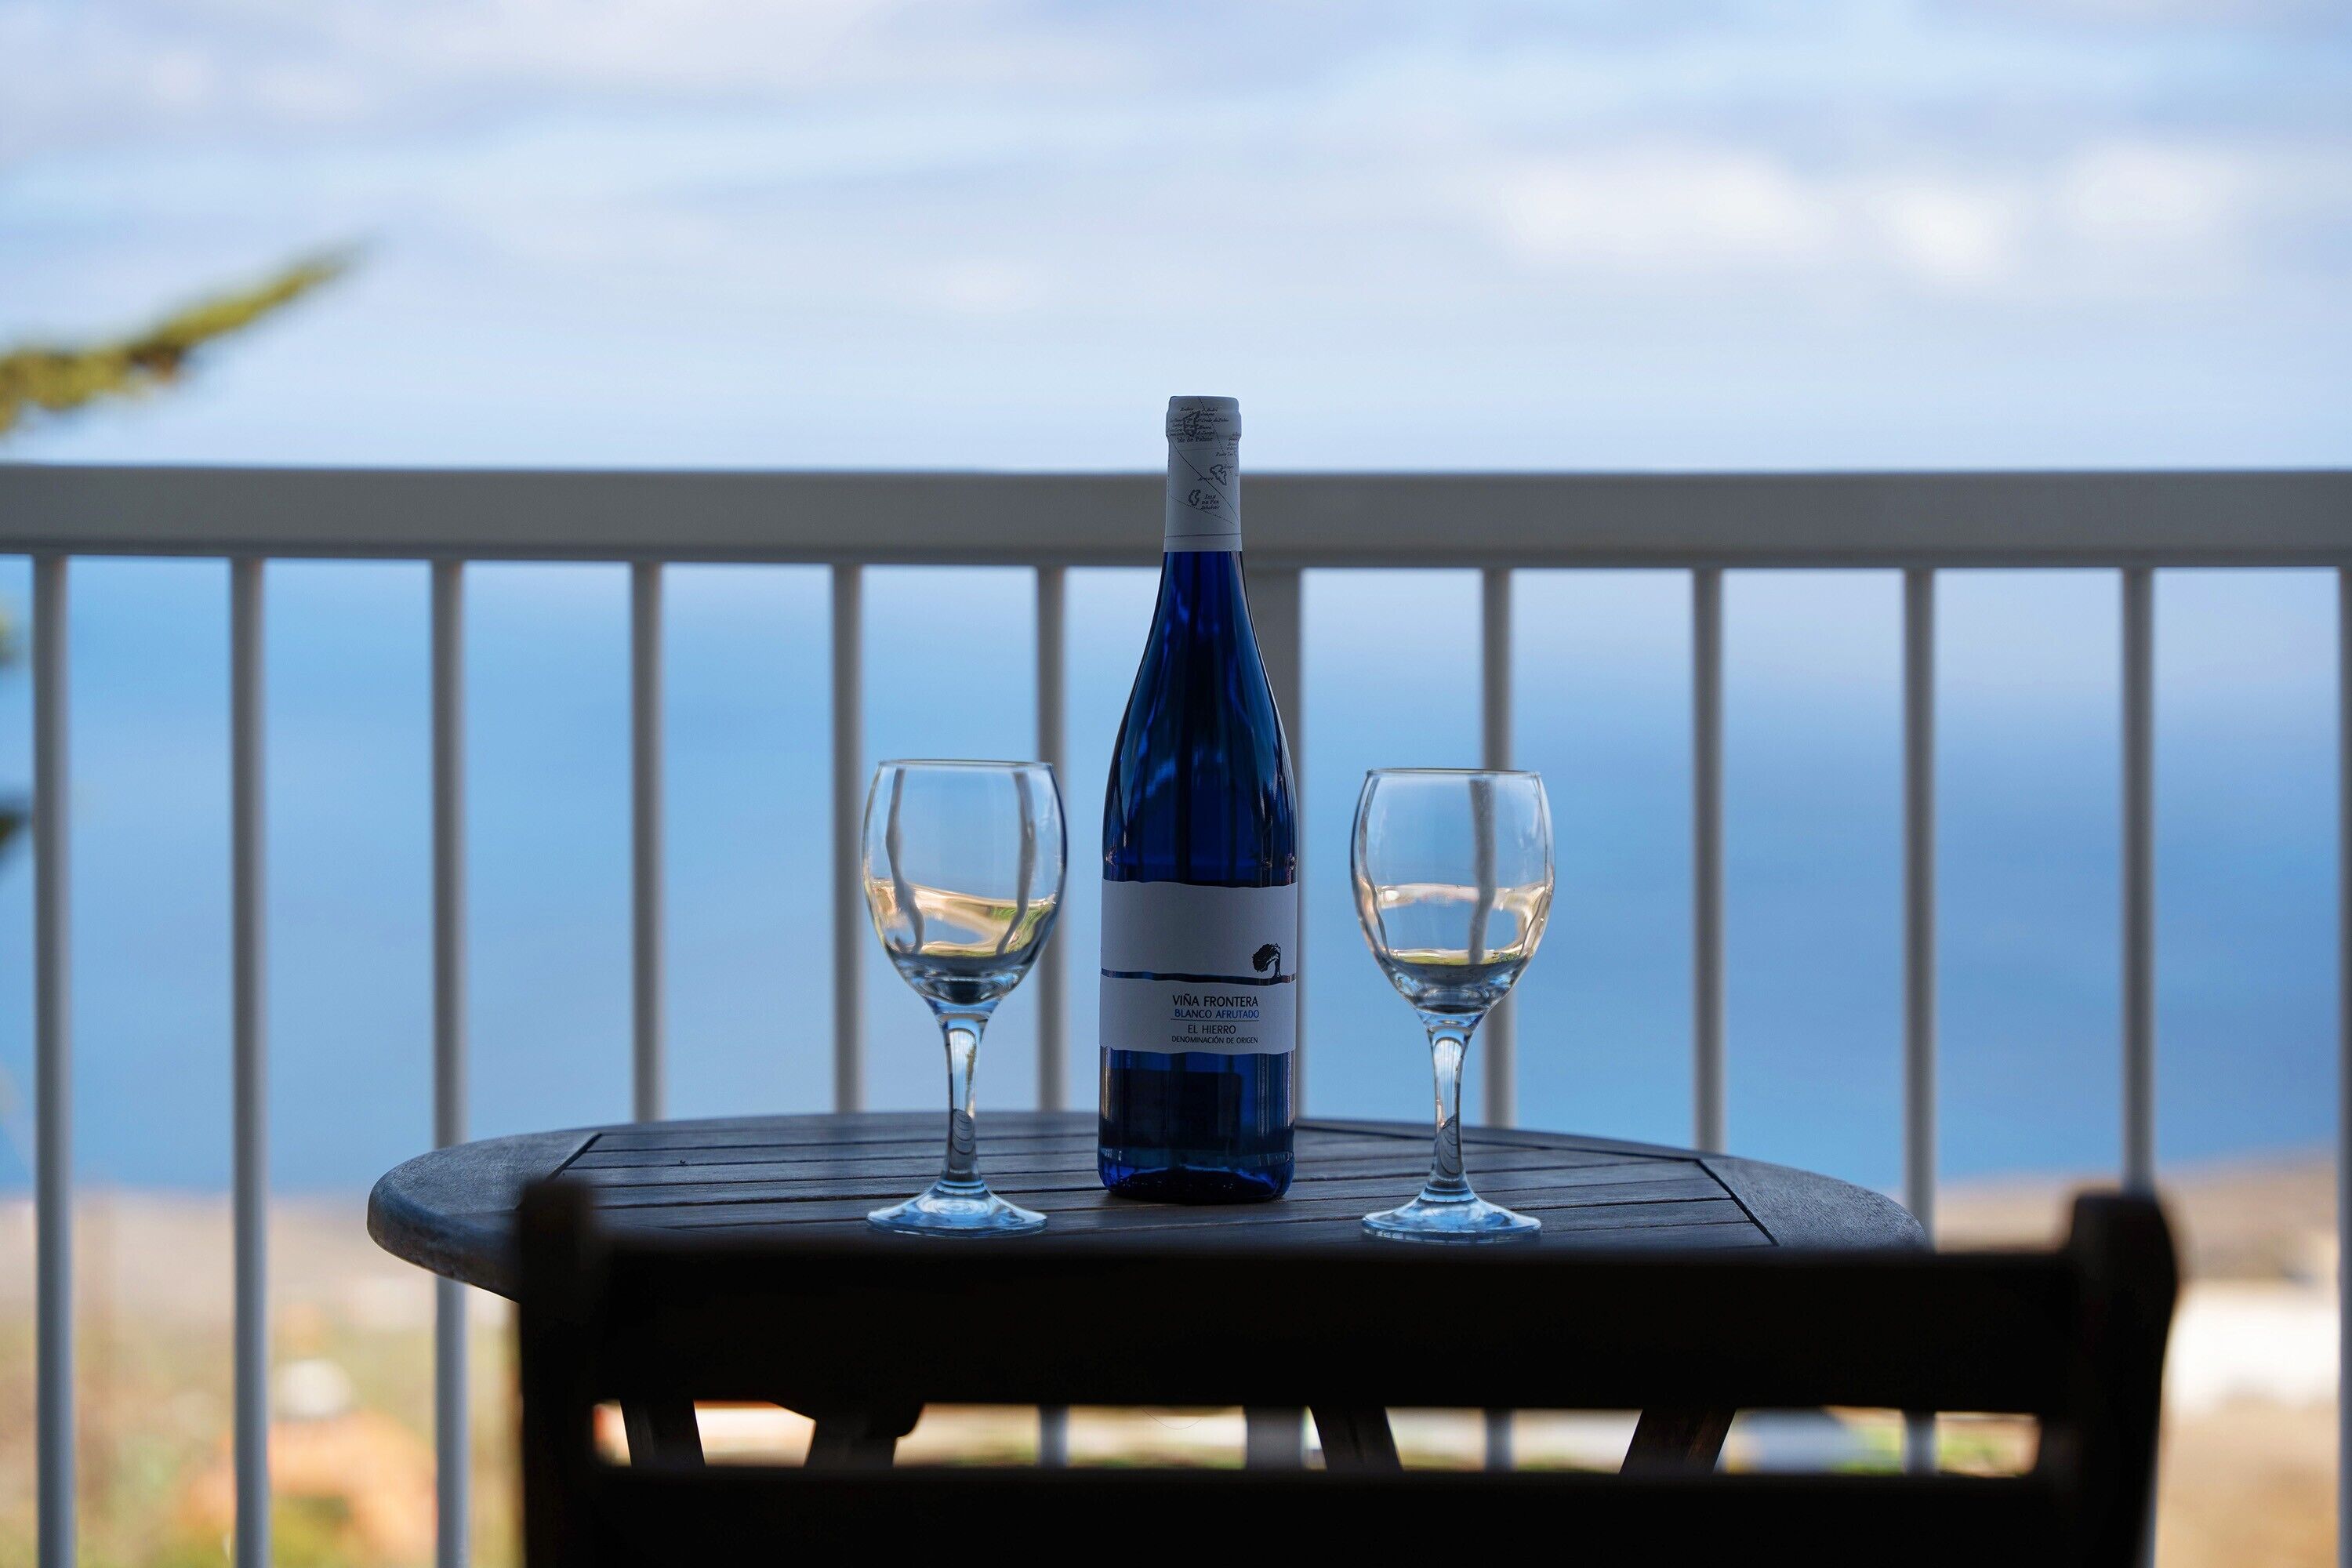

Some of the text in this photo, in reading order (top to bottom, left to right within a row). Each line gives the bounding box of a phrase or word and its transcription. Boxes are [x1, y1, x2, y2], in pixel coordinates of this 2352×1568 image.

[1173, 993, 1258, 1007] VIÑA FRONTERA
[1174, 1009, 1259, 1018] BLANCO AFRUTADO
[1188, 1024, 1236, 1034] EL HIERRO
[1171, 1036, 1224, 1044] DENOMINACIÓN
